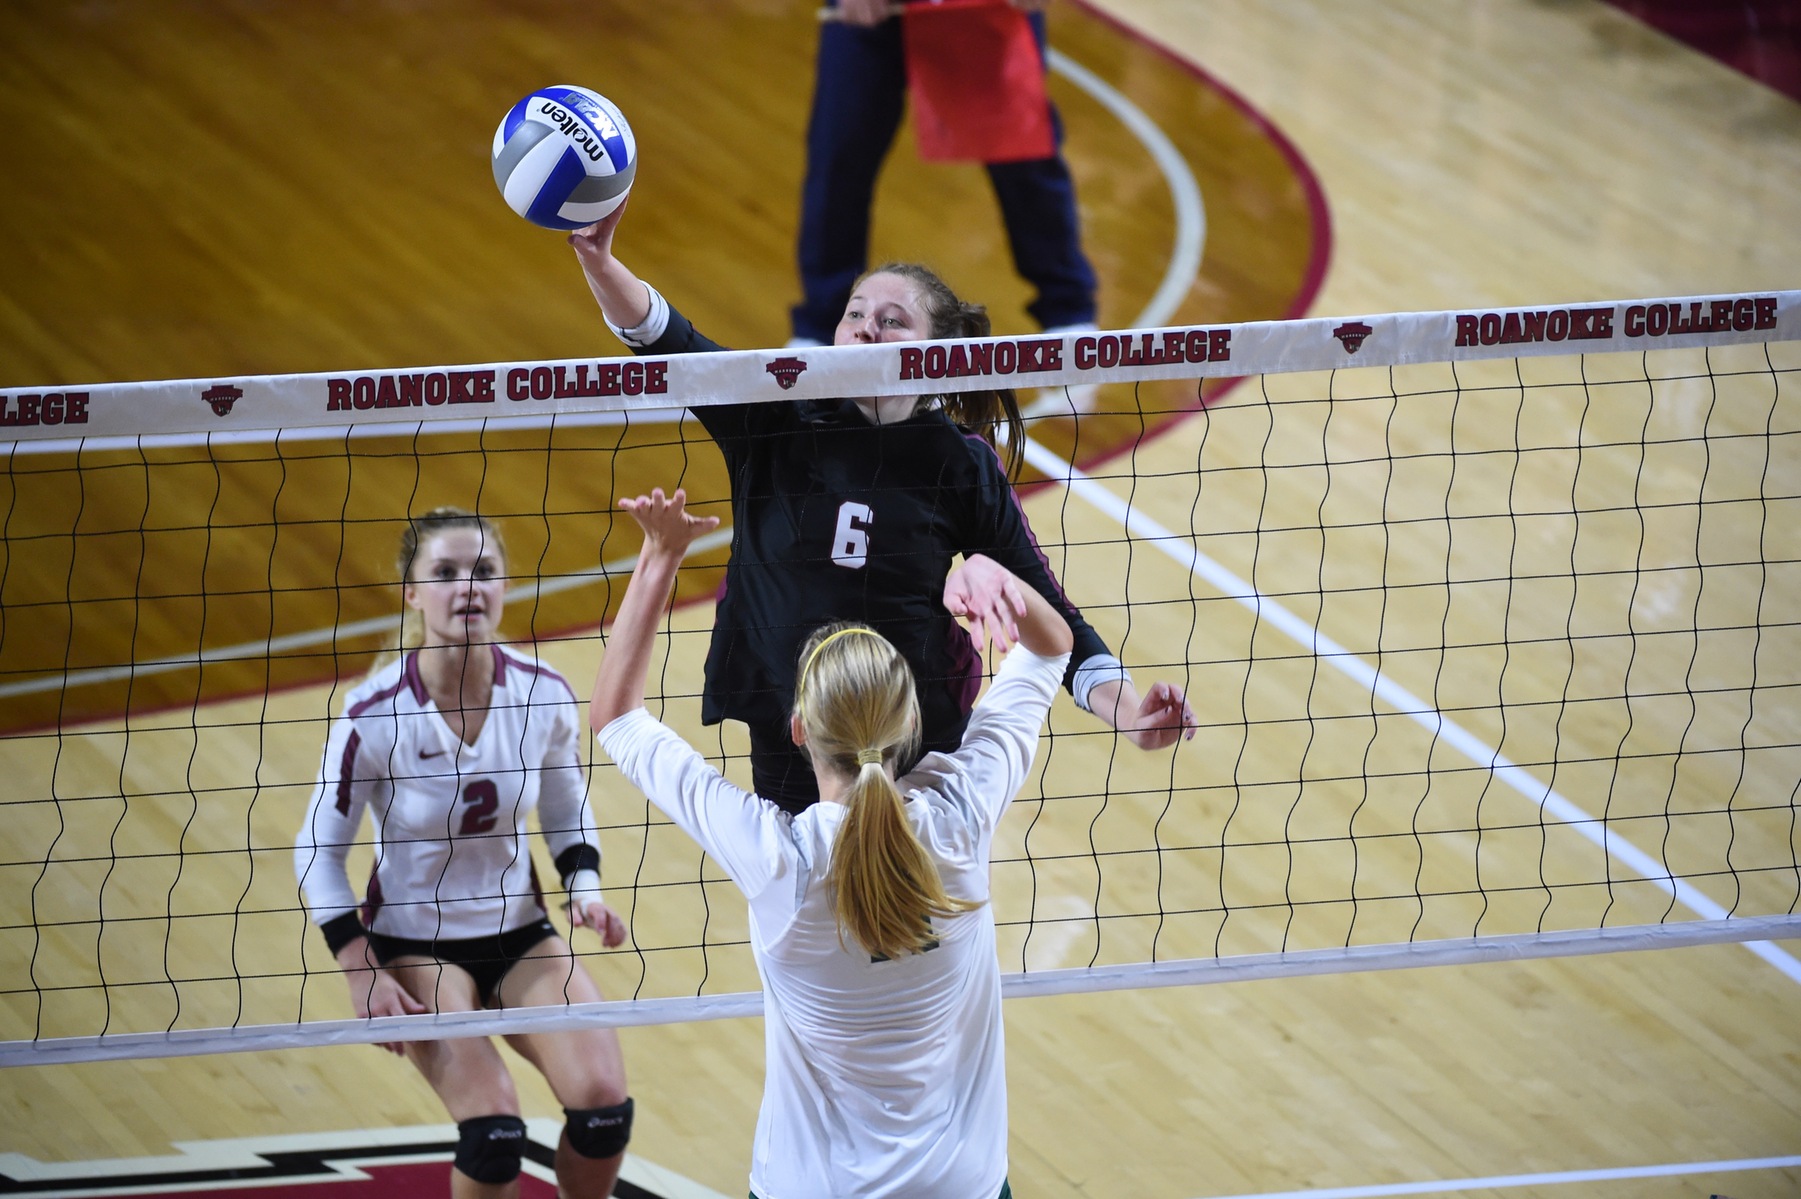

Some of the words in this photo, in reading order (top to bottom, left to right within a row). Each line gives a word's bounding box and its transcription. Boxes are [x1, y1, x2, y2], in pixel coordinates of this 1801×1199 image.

[541, 102, 604, 161] molten
[1455, 308, 1615, 347] ROANOKE
[1624, 297, 1778, 337] COLLEGE
[899, 339, 1063, 380] ROANOKE
[1074, 329, 1231, 370] COLLEGE
[327, 370, 496, 411] ROANOKE
[507, 361, 668, 401] COLLEGE
[830, 500, 874, 570] 6
[459, 779, 498, 835] 2
